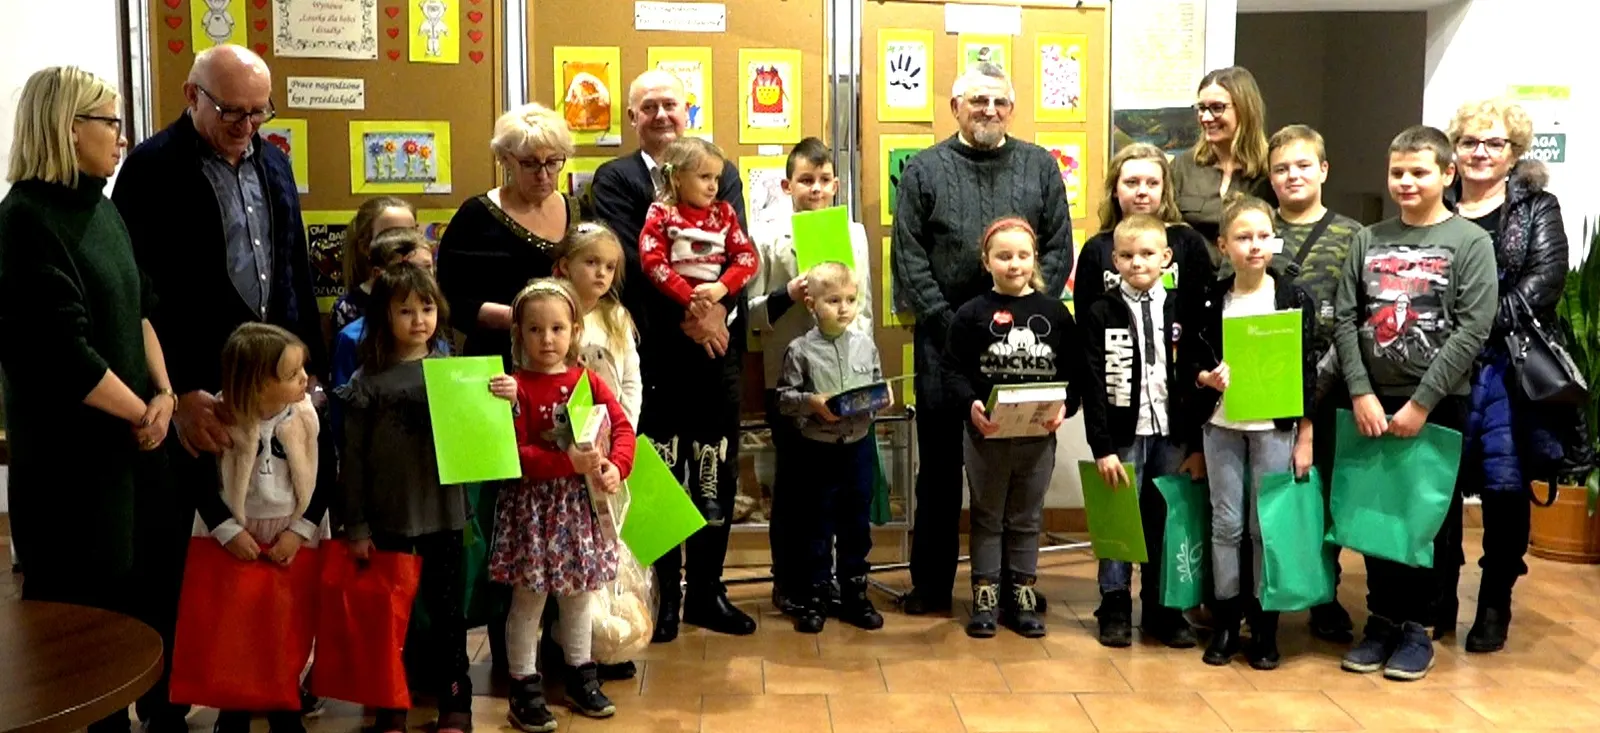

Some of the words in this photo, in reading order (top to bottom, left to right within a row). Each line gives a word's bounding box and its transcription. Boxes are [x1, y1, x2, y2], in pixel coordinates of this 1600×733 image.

[290, 80, 314, 88] Prace
[315, 81, 361, 91] nagrodzone
[309, 94, 356, 105] przedszkola
[1531, 136, 1558, 148] AGA
[983, 355, 1055, 370] MICKEY
